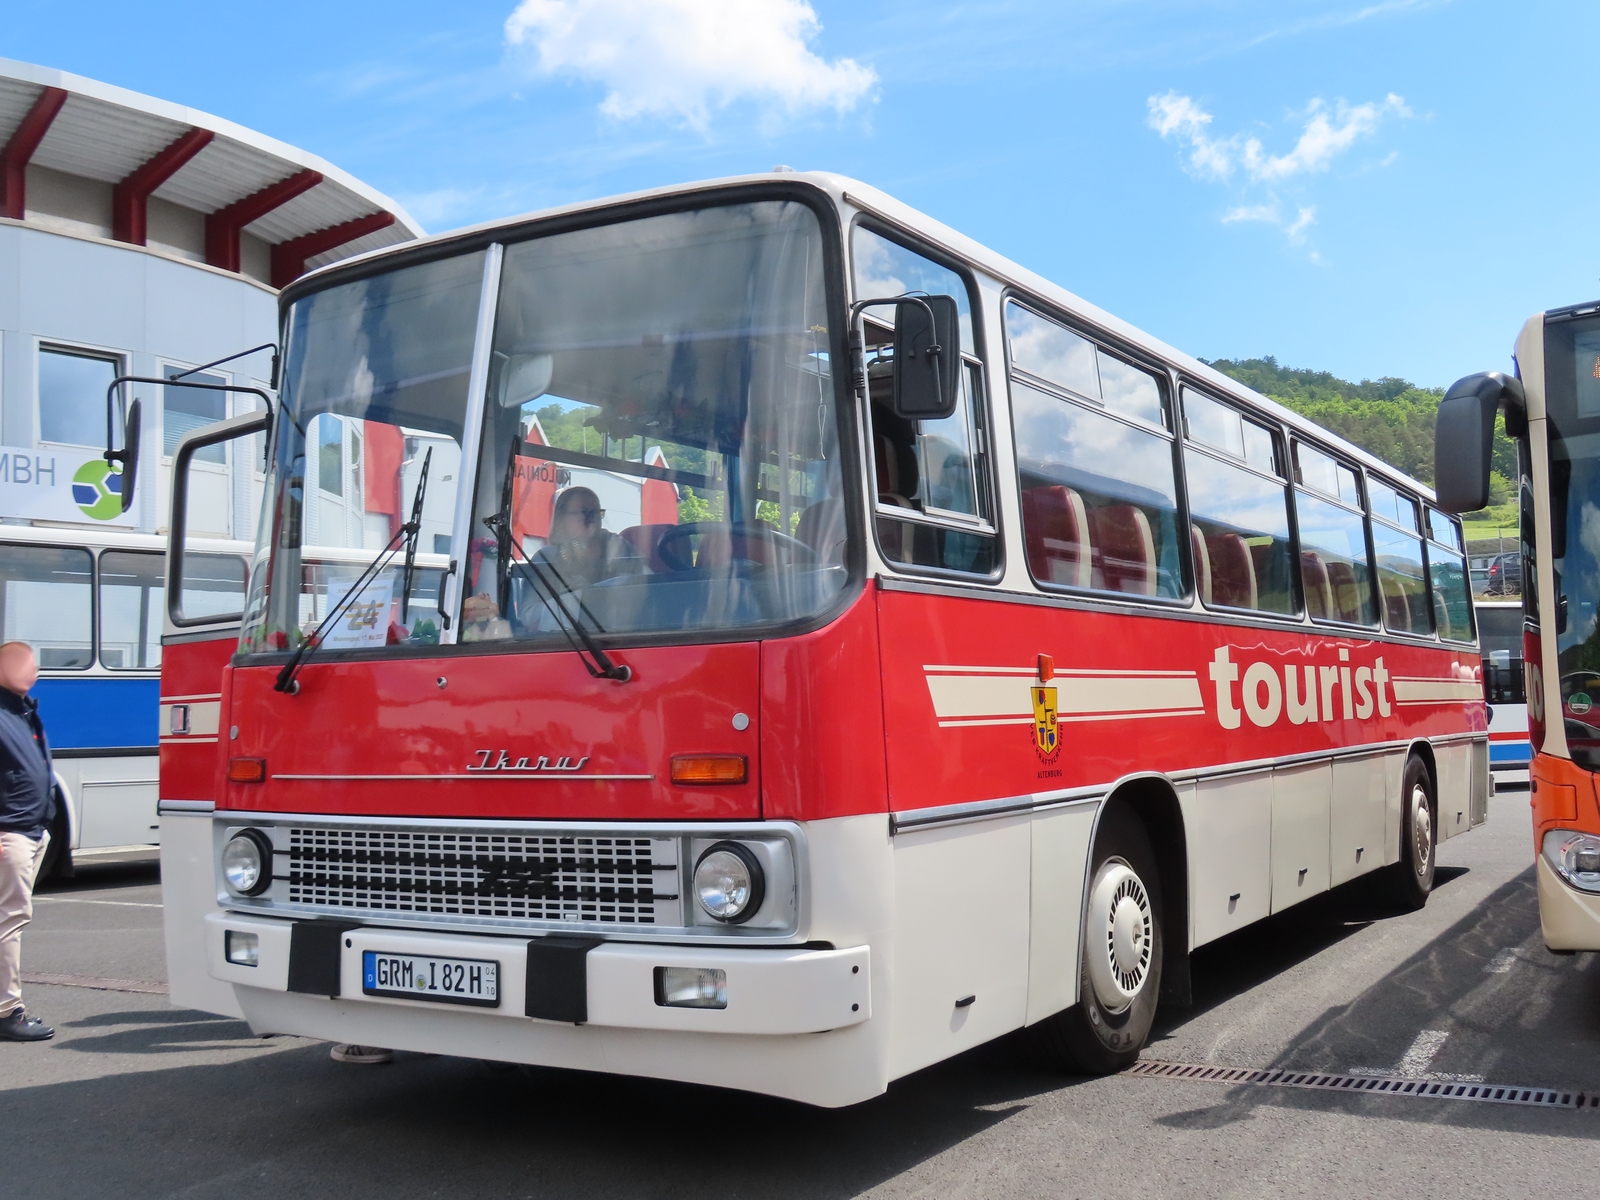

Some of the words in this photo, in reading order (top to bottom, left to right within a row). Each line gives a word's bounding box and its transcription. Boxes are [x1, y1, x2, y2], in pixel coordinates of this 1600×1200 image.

[347, 599, 378, 631] 24
[1208, 644, 1391, 730] tourist
[466, 749, 589, 771] Ikarus
[1037, 769, 1062, 778] ALTENBURG
[367, 974, 374, 982] D
[377, 958, 413, 988] GRM
[485, 967, 495, 976] 04
[486, 986, 496, 995] 10
